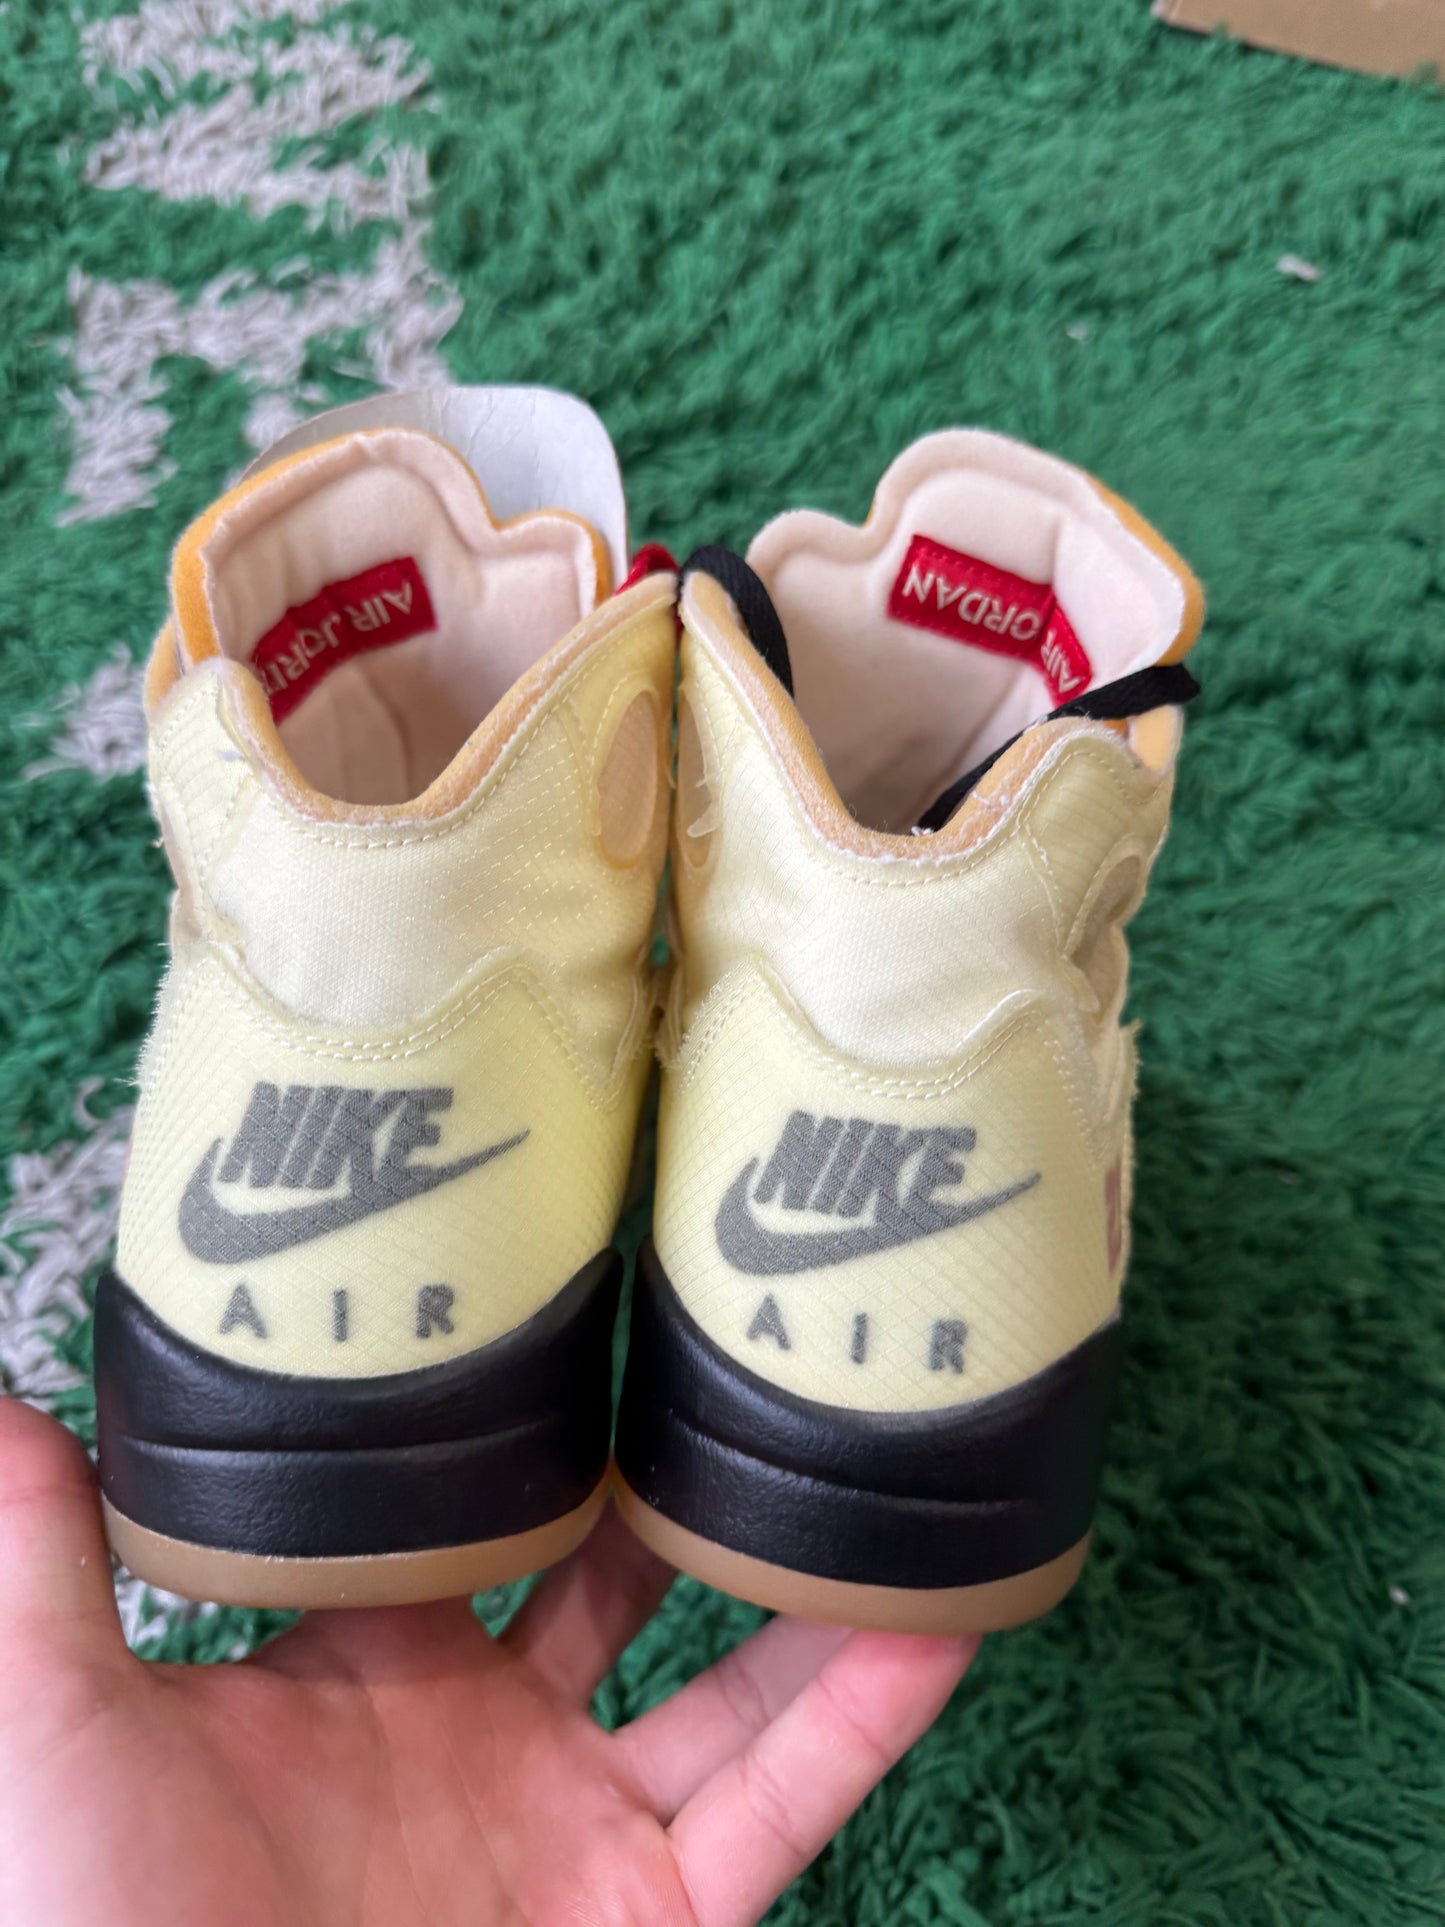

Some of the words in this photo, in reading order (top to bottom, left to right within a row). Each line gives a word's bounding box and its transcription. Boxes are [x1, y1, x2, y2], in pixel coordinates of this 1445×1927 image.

[343, 581, 413, 632] AIR
[902, 562, 1042, 642] ORDAN
[261, 613, 341, 694] JORD
[1039, 628, 1084, 693] AIR
[216, 1080, 454, 1190] NIKE
[753, 1109, 977, 1218] NIKE
